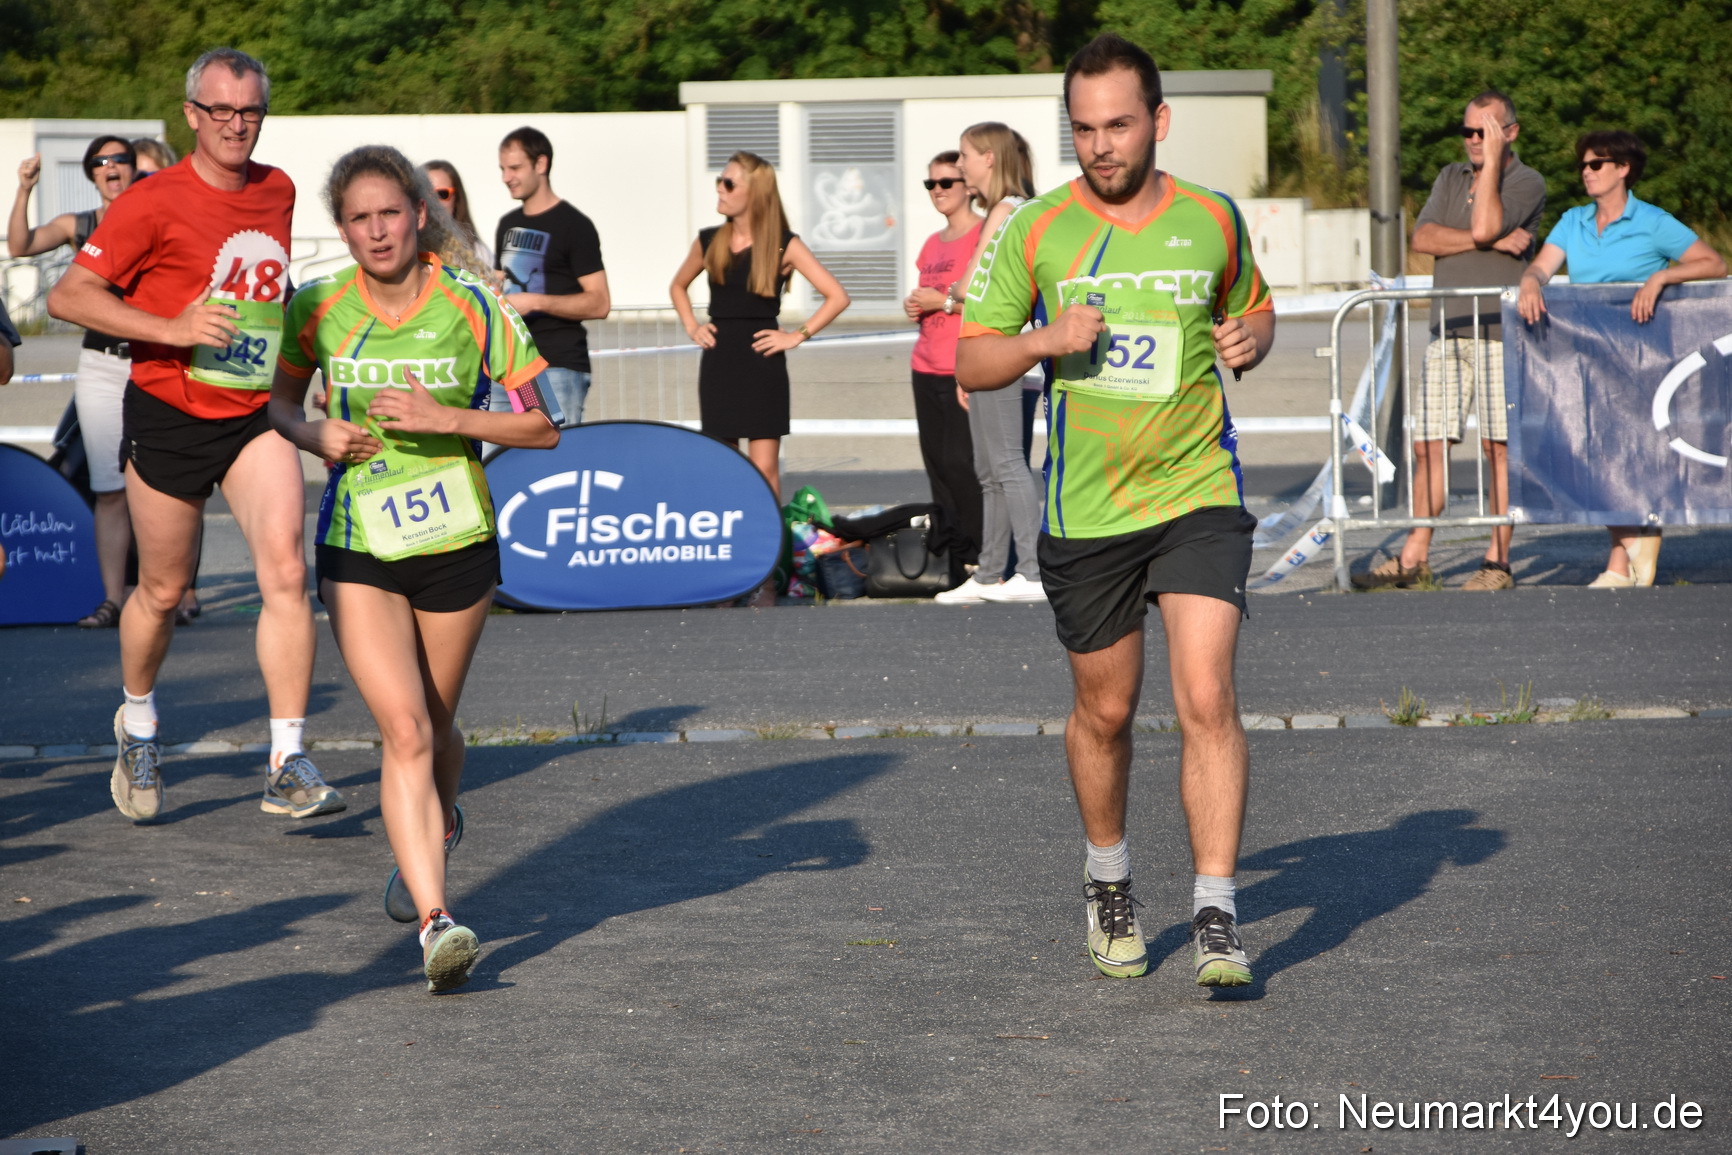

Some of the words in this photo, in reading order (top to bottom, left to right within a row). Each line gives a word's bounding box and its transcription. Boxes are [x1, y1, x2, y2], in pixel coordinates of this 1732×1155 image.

[503, 230, 545, 252] PUMA
[220, 256, 283, 302] 48
[1056, 269, 1214, 307] OCK
[329, 355, 460, 389] BOCK
[1108, 375, 1150, 385] Czerwinski
[380, 481, 451, 528] 151
[1, 510, 76, 538] Lächeln
[401, 529, 429, 541] Kerstin
[428, 523, 448, 533] Bock
[545, 501, 744, 547] Fischer
[34, 541, 77, 565] mit!
[567, 543, 733, 568] AUTOMOBILE
